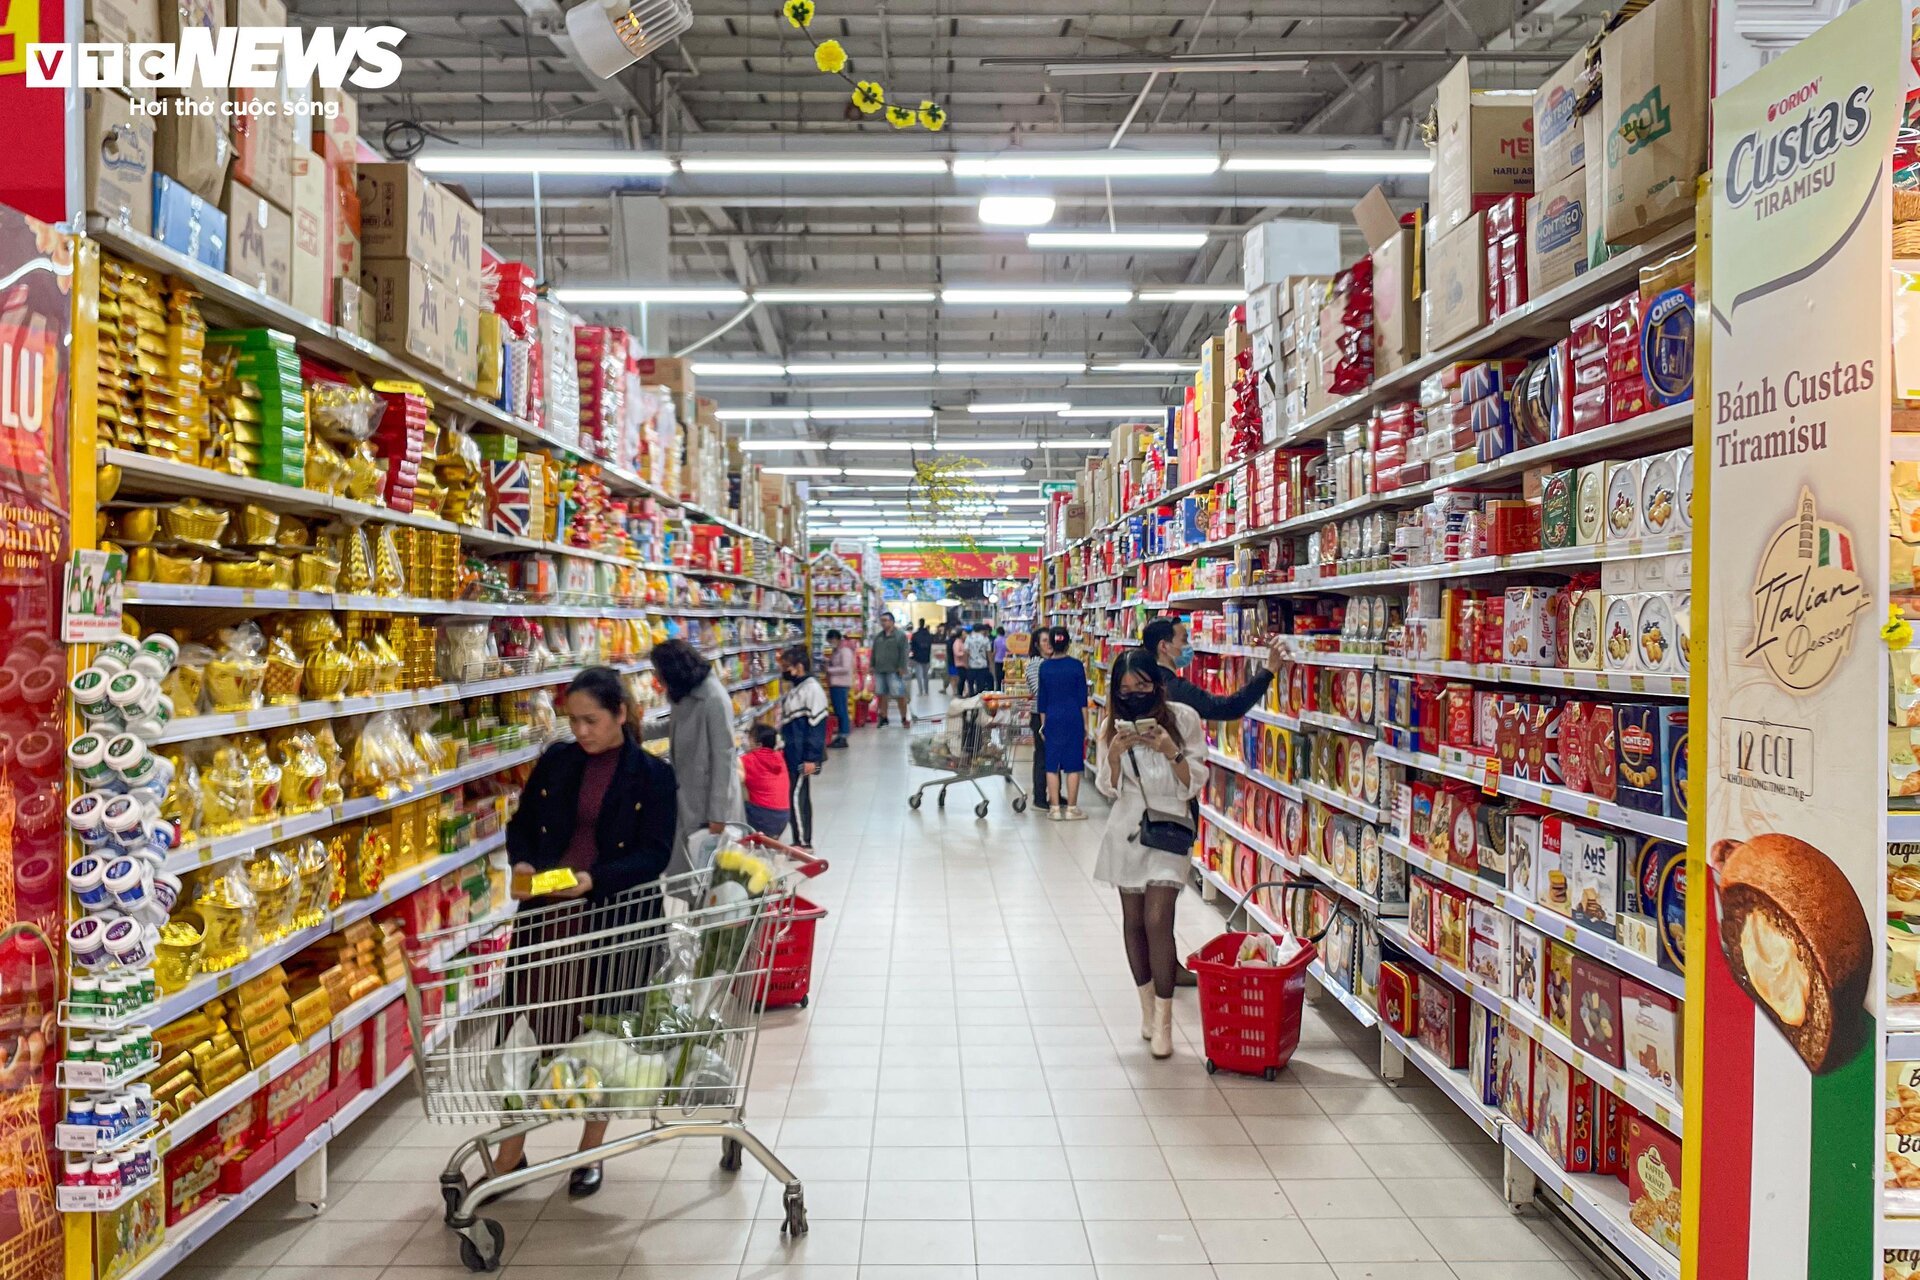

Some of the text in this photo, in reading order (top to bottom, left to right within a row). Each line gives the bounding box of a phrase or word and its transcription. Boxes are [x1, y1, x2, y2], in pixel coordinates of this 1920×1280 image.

[1776, 78, 1819, 116] ORION
[1725, 84, 1871, 206] Custas
[1754, 161, 1836, 221] TIRAMISU
[1651, 293, 1685, 321] OREO
[1716, 359, 1875, 425] Bánh Custas
[1716, 415, 1828, 468] Tiramisu
[1735, 730, 1755, 772] 12
